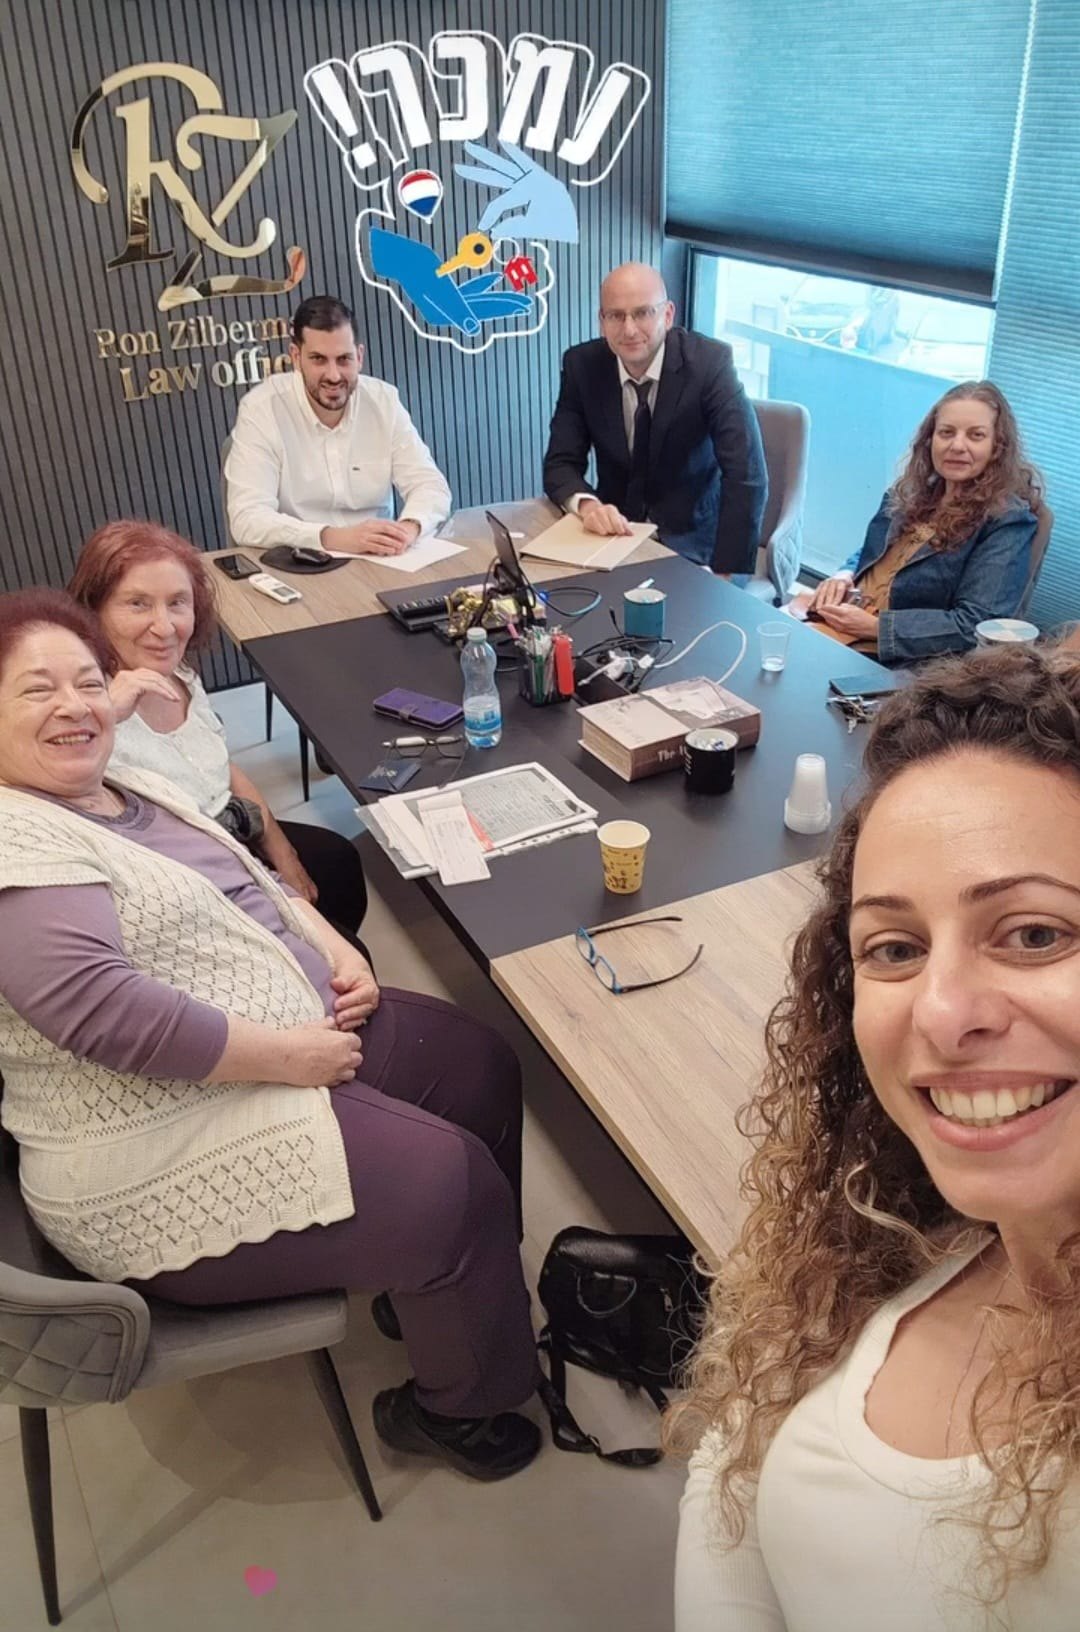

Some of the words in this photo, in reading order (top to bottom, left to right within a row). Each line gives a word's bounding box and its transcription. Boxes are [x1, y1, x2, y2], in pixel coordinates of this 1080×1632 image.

[94, 328, 161, 359] Ron
[168, 315, 295, 350] Zilberm
[119, 362, 202, 403] Law
[211, 345, 293, 389] offic
